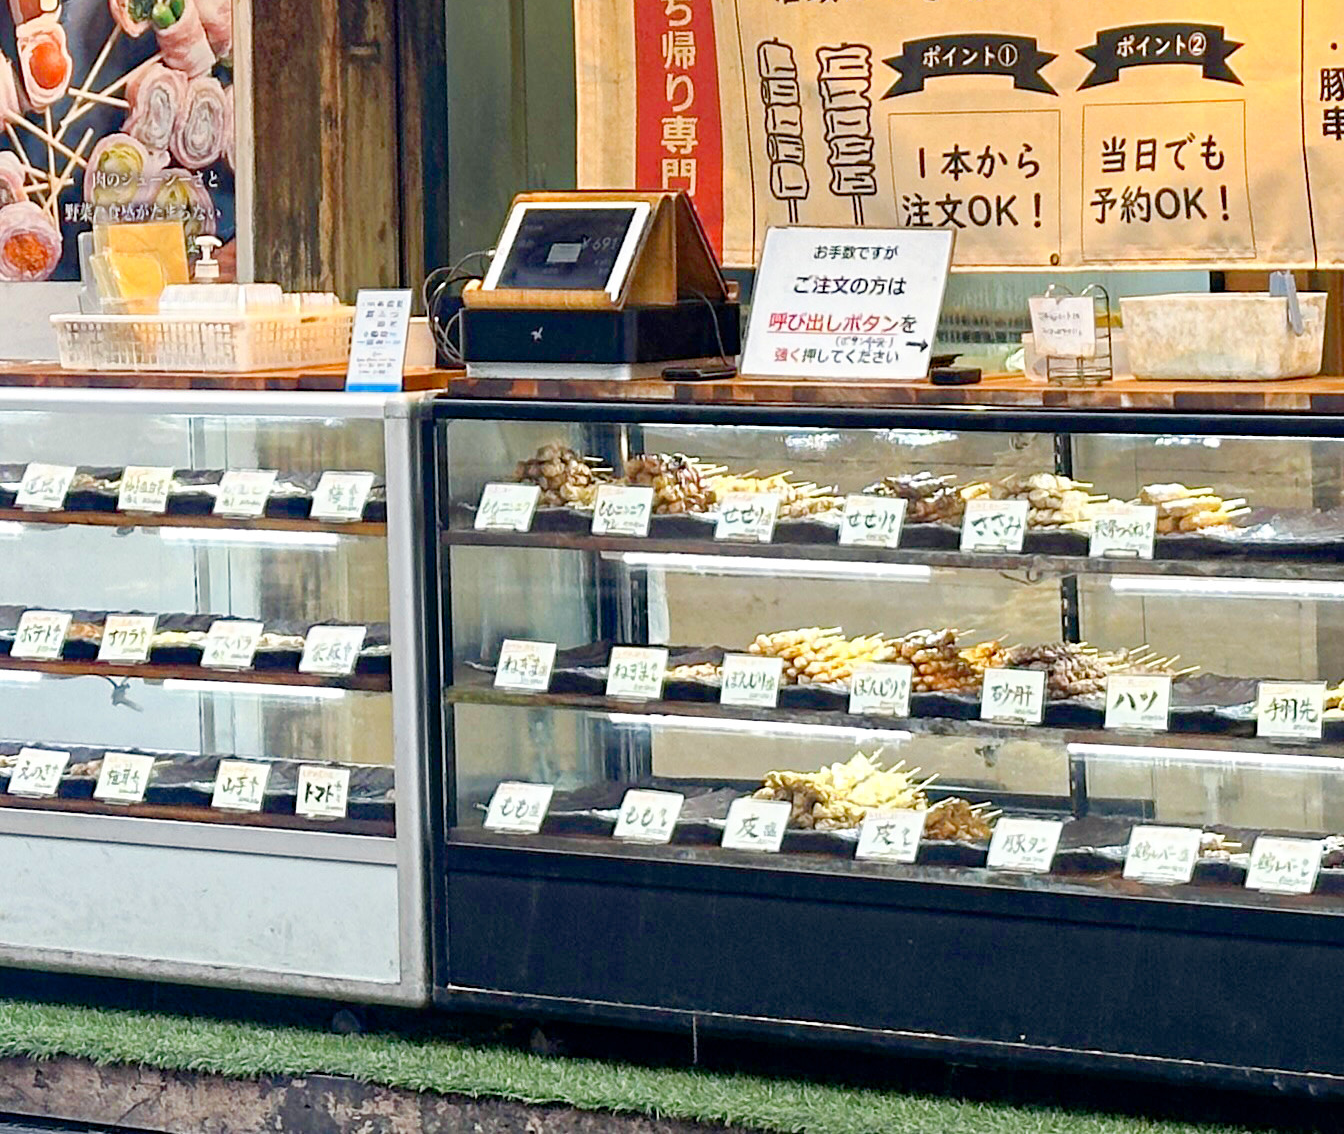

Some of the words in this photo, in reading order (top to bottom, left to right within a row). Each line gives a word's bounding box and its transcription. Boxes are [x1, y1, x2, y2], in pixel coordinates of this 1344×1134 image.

[1100, 134, 1225, 172] 当日でも
[92, 169, 219, 188] 肉のジューシーさと
[813, 245, 900, 260] お手数ですが
[793, 276, 907, 296] ご注文の方は
[768, 312, 918, 334] 呼び出しボタンを
[774, 348, 899, 364] 強く押してください
[990, 681, 1034, 708] 砂肝
[1113, 690, 1158, 712] ハツ
